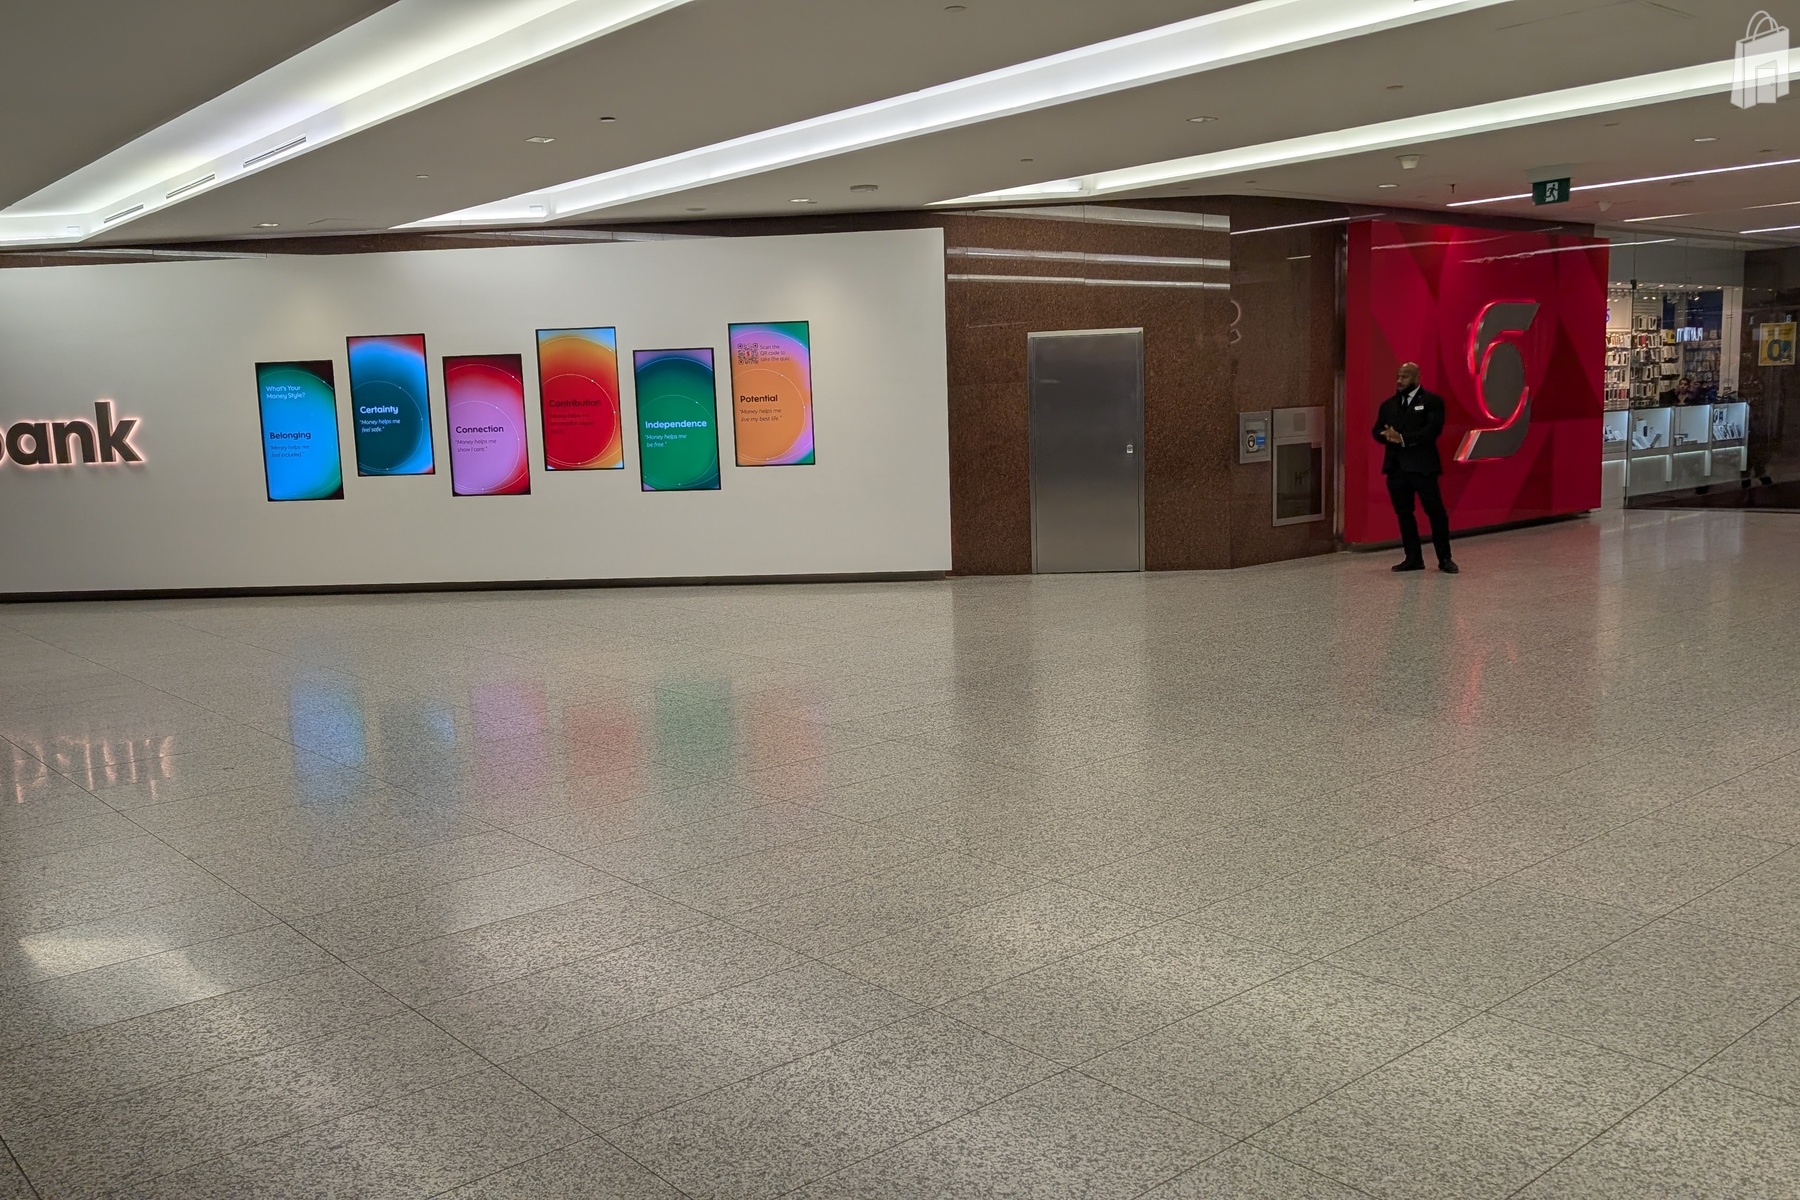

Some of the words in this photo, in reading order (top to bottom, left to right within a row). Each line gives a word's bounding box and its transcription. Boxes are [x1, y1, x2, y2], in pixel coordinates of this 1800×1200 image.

[288, 392, 306, 400] Style?
[740, 394, 778, 403] Potential
[548, 399, 602, 408] Contribution
[360, 405, 399, 414] Certainty
[456, 425, 504, 434] Connection
[645, 420, 707, 430] Independence
[0, 401, 143, 466] ank
[269, 431, 312, 440] Belonging
